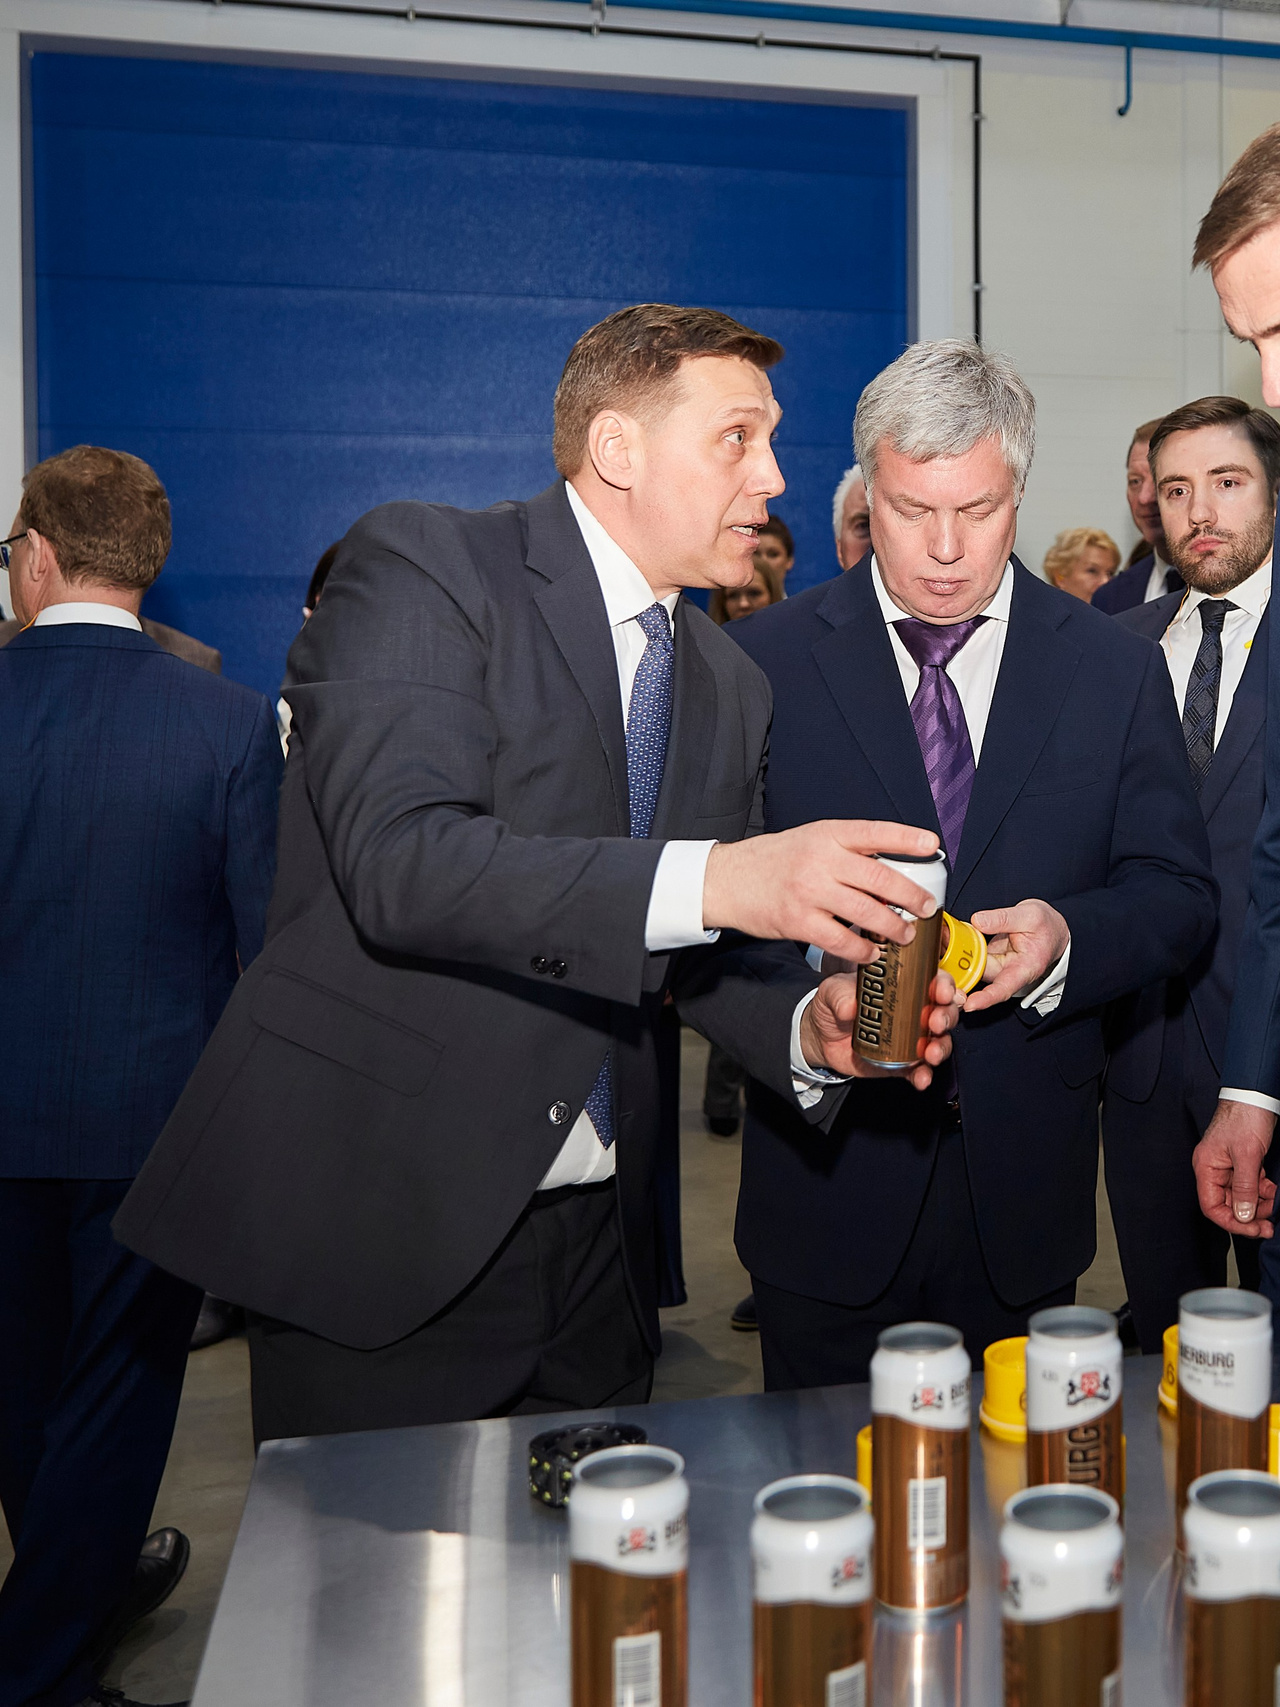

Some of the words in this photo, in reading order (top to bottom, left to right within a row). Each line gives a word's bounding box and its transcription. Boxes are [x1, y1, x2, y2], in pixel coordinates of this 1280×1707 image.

[958, 949, 973, 971] 10
[888, 959, 903, 988] Barley
[886, 990, 899, 1012] Hops
[1166, 1362, 1175, 1386] 6
